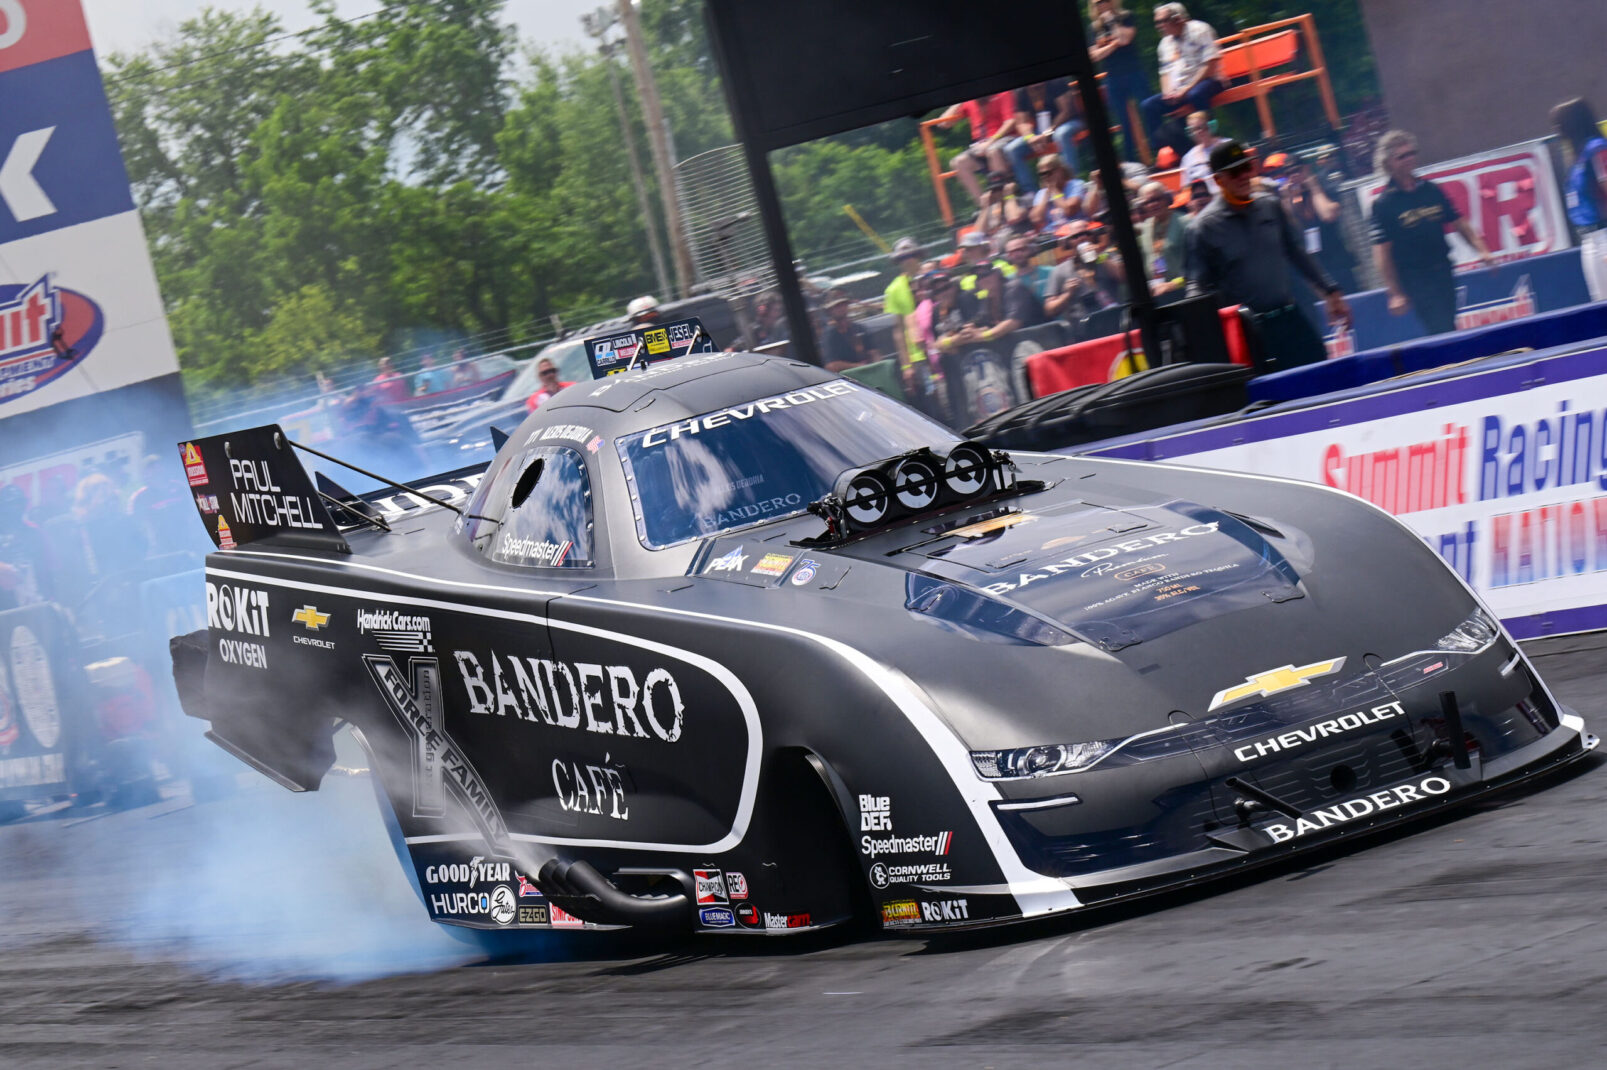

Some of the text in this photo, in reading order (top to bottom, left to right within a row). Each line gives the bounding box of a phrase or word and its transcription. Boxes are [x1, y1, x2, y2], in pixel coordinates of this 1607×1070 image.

[642, 380, 860, 449] CHEVROLET
[230, 459, 281, 493] PAUL
[230, 492, 323, 529] MITCHELL
[701, 492, 801, 529] BANDERO
[502, 532, 559, 561] Speedmaster
[979, 520, 1220, 596] BANDERO
[703, 553, 749, 575] PEAK
[219, 638, 268, 669] OXYGEN
[293, 635, 336, 650] CHEVROLET
[453, 649, 686, 743] BANDERO
[1233, 700, 1407, 762] CHEVROLET
[383, 666, 444, 752] FORCE
[440, 748, 510, 843] FAMILY
[551, 751, 630, 821] CAFÉ
[859, 794, 891, 812] Blue
[1261, 776, 1451, 845] BANDERO
[860, 811, 892, 832] DEF
[861, 834, 938, 859] Speedmaster
[888, 863, 951, 876] CORNWELL
[889, 873, 951, 883] QUALITY TOOLS
[431, 892, 490, 915] HURCO
[698, 881, 724, 895] CHAMPION
